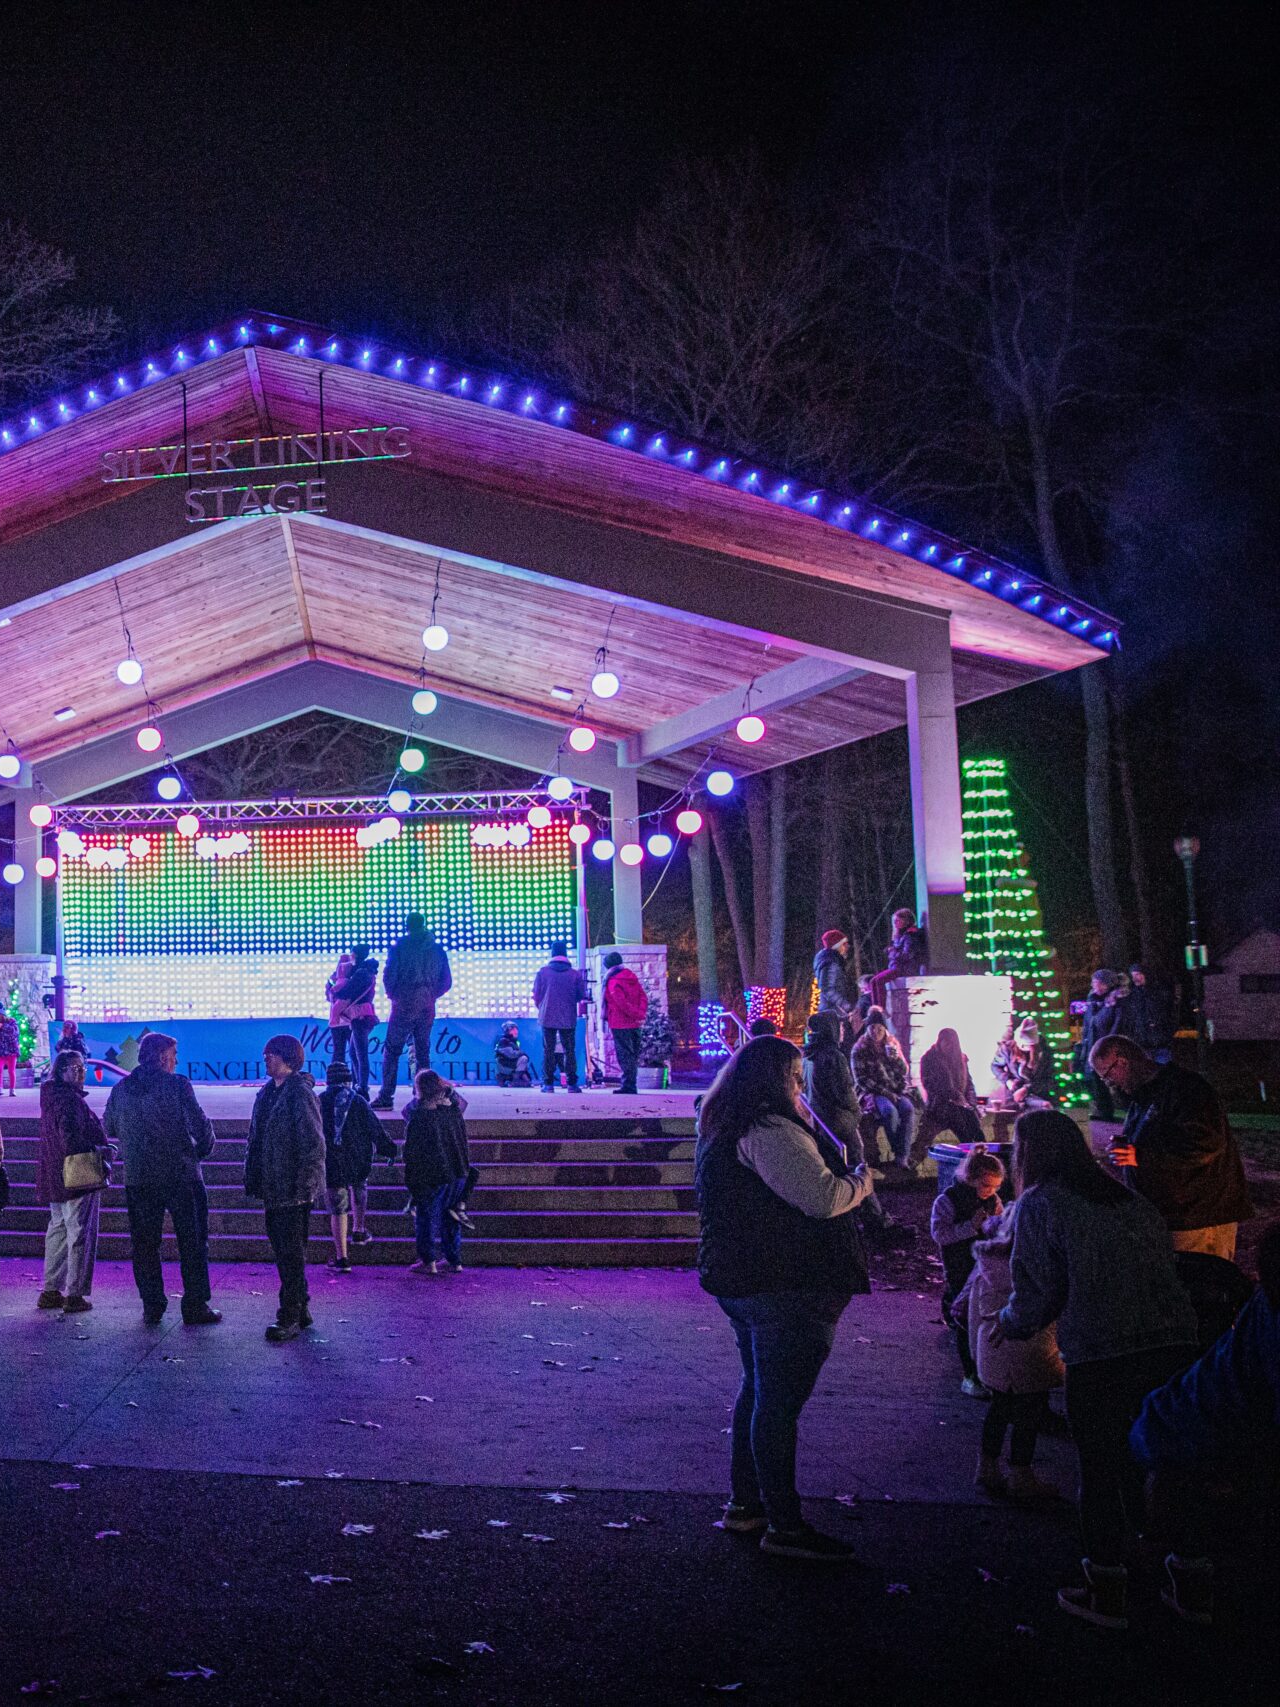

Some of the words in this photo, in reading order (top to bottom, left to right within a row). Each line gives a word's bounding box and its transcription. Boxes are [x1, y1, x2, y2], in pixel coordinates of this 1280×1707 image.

[101, 440, 237, 483] SILVER
[253, 426, 412, 470] LINING
[185, 478, 328, 523] STAGE
[436, 1026, 463, 1054] to
